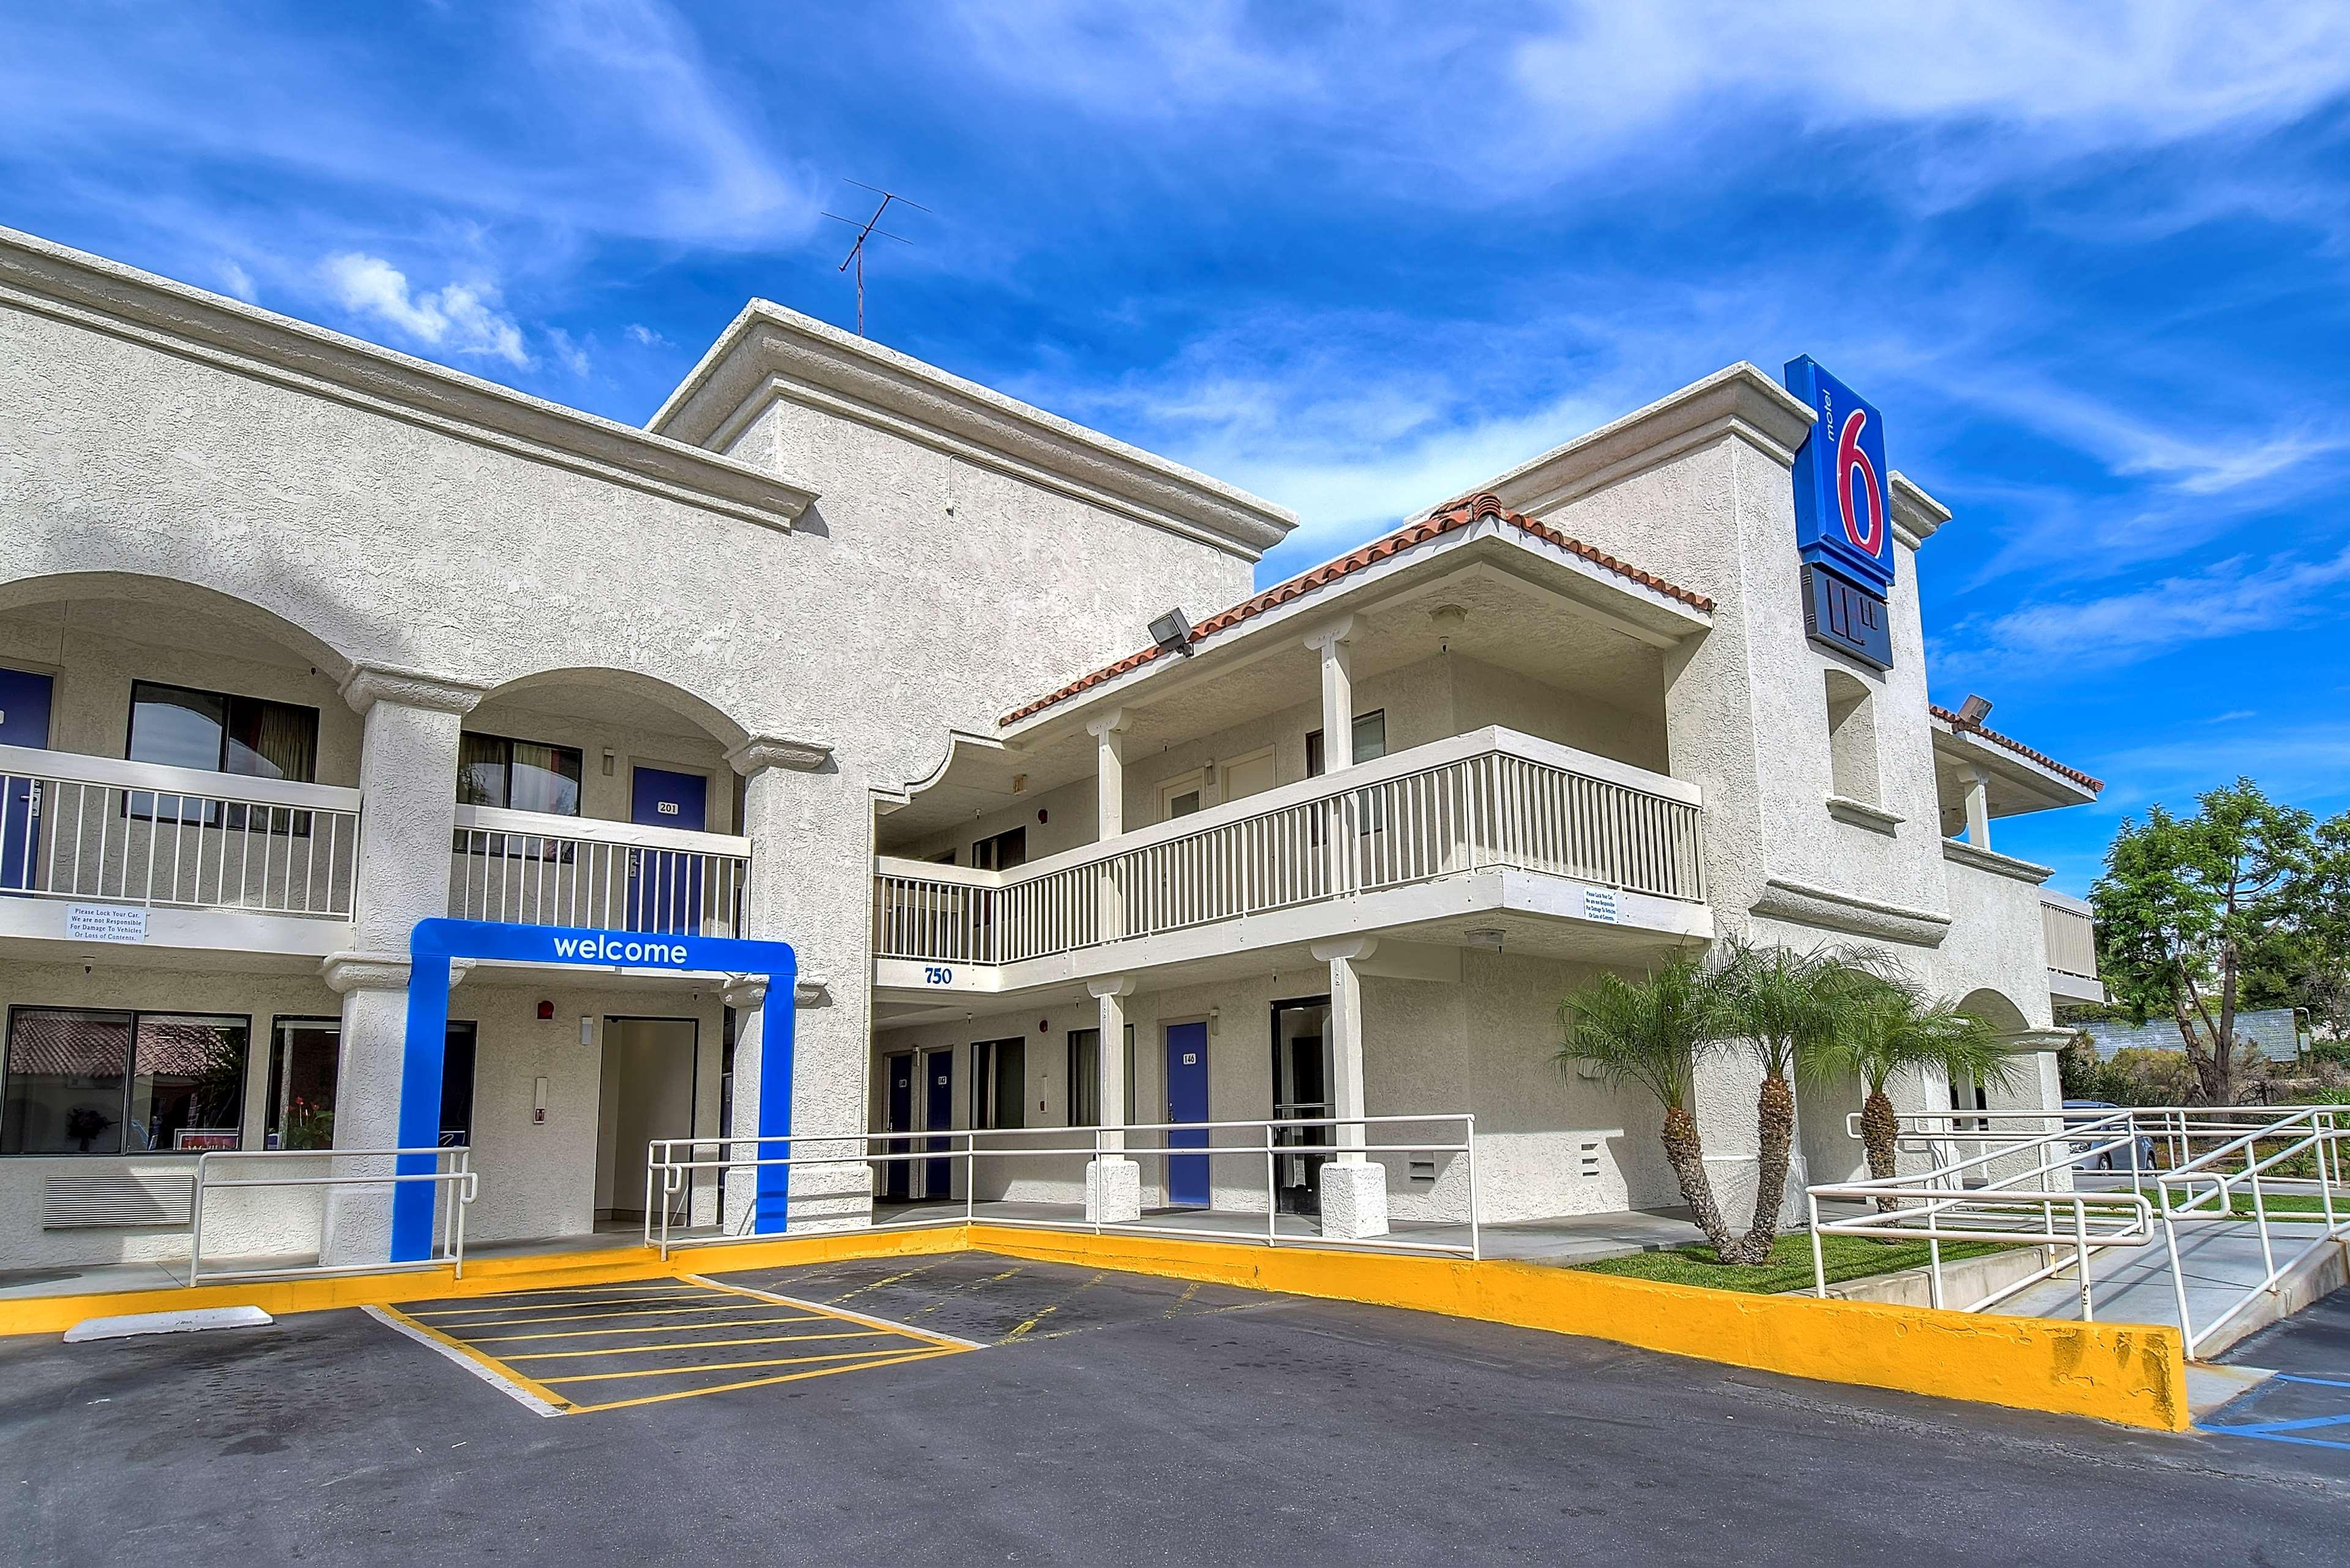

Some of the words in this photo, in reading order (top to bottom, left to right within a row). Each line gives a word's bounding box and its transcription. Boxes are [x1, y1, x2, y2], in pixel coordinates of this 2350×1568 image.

[1822, 389, 1835, 442] motel
[1837, 408, 1884, 559] 6
[660, 804, 676, 813] 201
[553, 935, 688, 964] welcome
[925, 967, 952, 984] 750
[1185, 1055, 1195, 1063] 146
